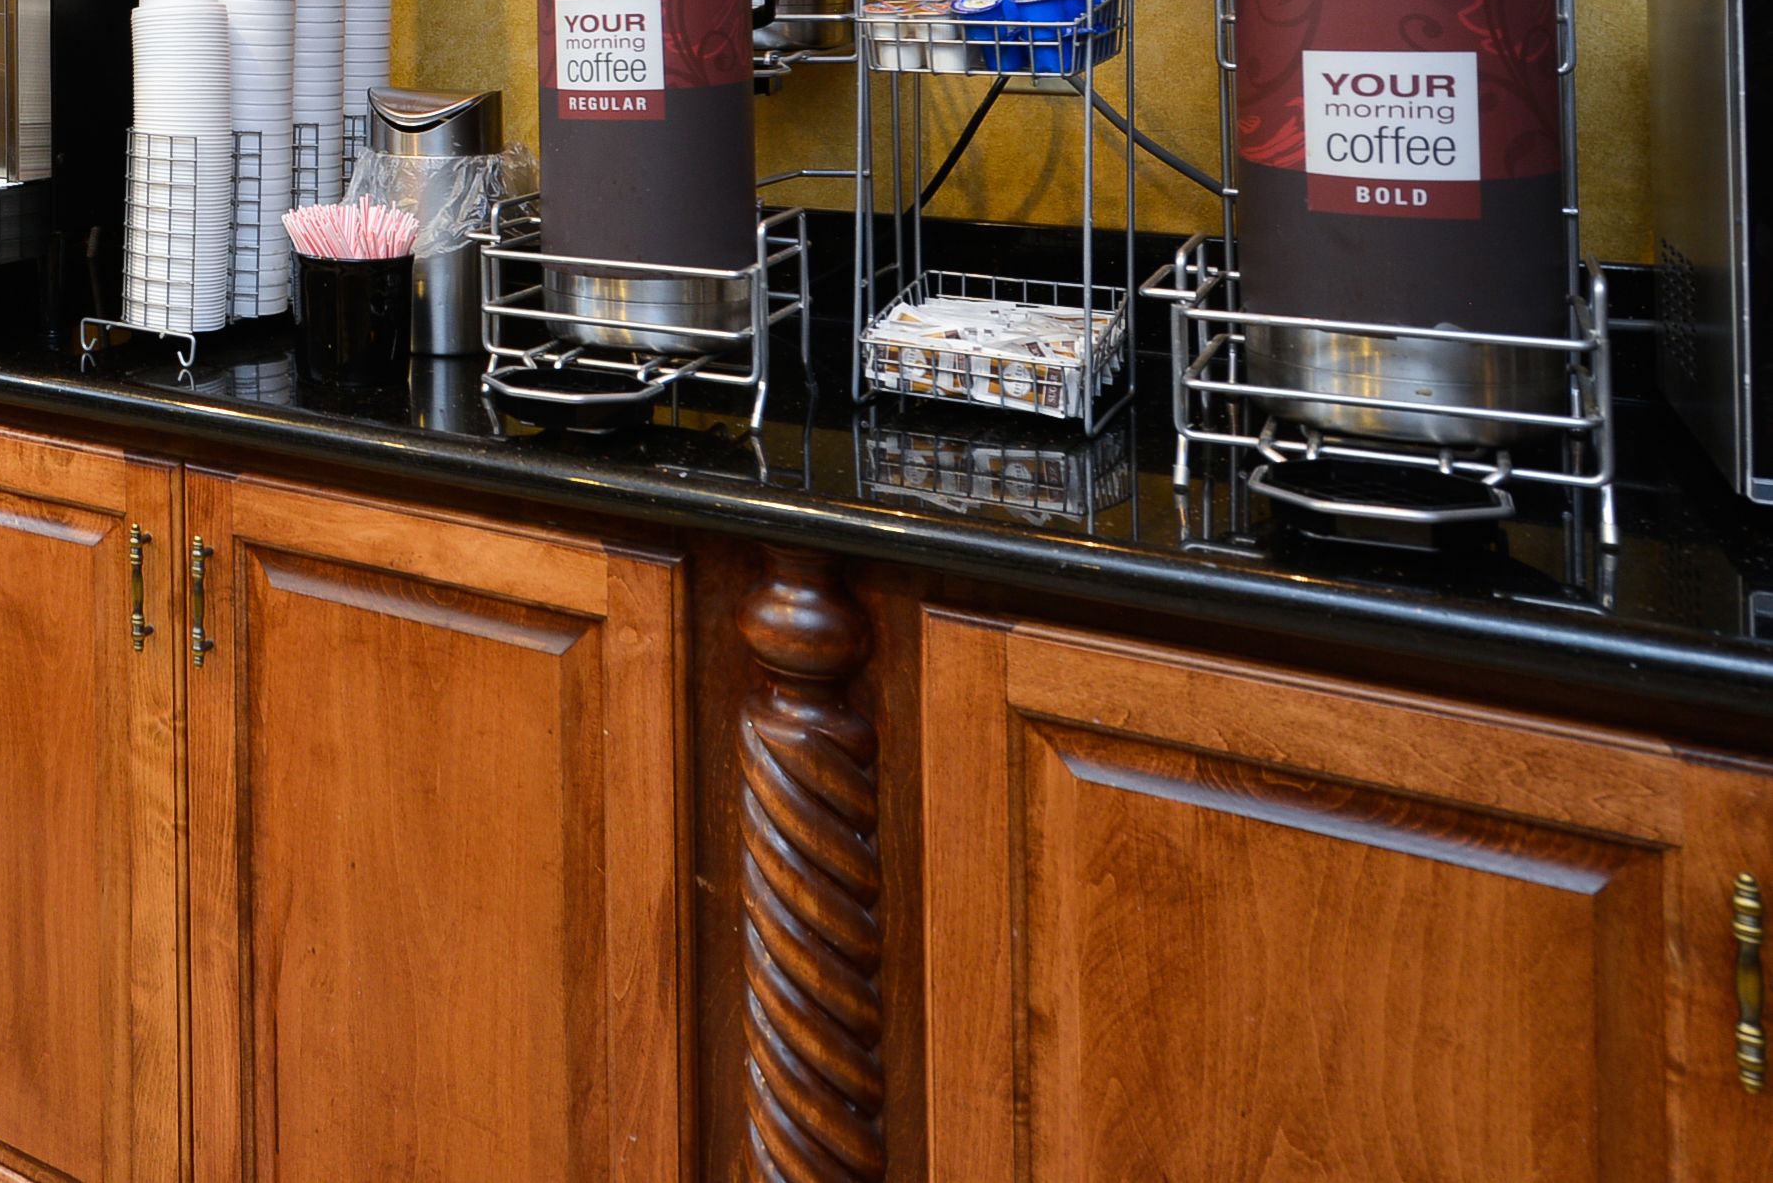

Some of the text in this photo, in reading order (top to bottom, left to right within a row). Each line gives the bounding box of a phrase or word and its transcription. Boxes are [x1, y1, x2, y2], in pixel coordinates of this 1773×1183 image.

[564, 13, 646, 33] YOUR
[566, 34, 646, 53] morning
[567, 52, 647, 83] coffee
[1322, 72, 1456, 98] YOUR
[568, 96, 647, 111] REGULAR
[1325, 101, 1456, 125] morning
[1327, 125, 1457, 166] coffee
[1355, 185, 1428, 206] BOLD
